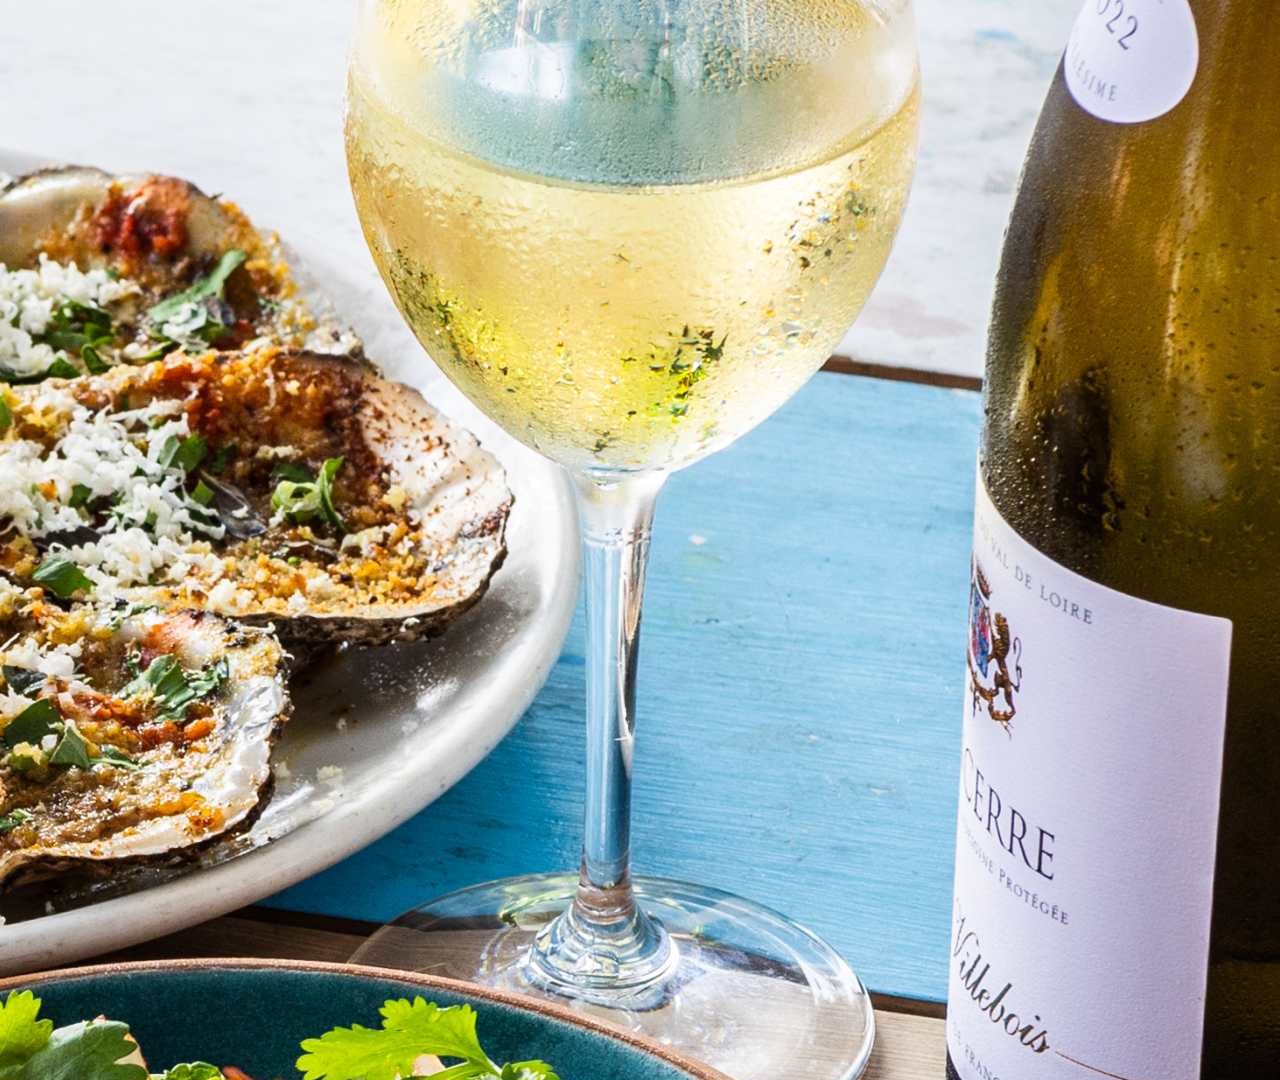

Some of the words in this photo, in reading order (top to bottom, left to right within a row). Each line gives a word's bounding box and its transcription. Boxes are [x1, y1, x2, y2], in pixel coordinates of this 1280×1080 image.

[1014, 565, 1033, 590] DE
[1039, 584, 1093, 625] LOIRE
[998, 867, 1070, 926] PROTÉGÉE
[953, 912, 1051, 1054] Villebois
